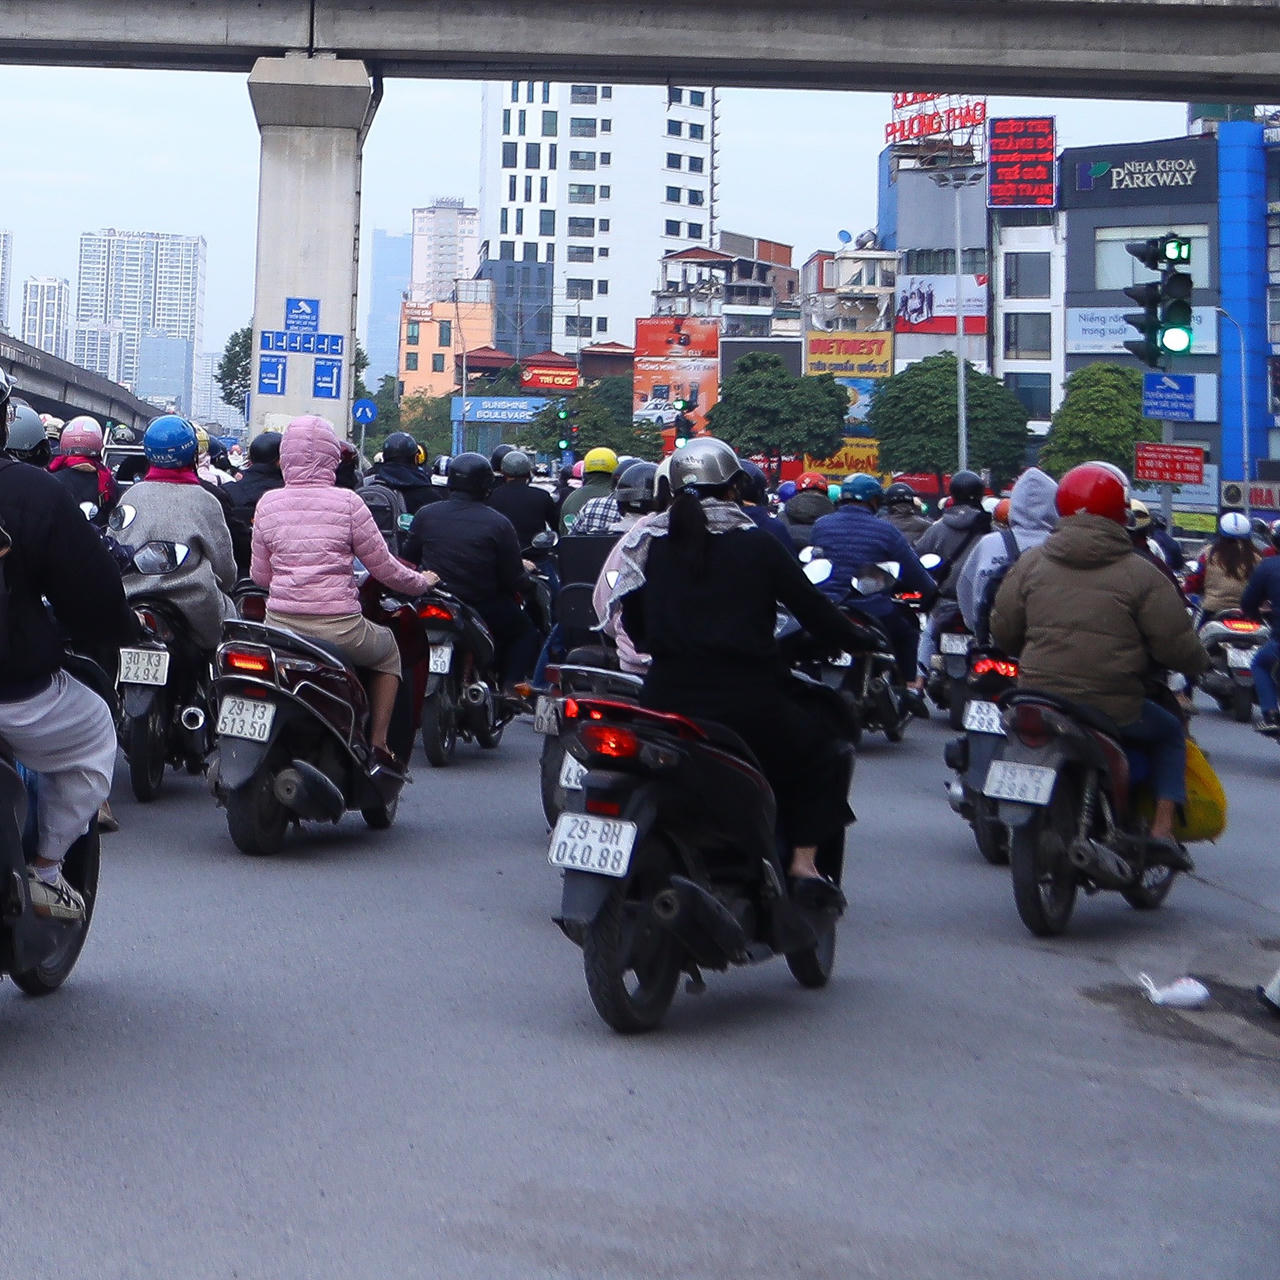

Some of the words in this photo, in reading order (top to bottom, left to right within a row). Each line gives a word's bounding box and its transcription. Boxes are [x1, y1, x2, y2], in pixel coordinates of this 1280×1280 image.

[1124, 161, 1154, 172] NHA
[1155, 159, 1196, 171] KHOA
[1110, 168, 1197, 190] PARKWAY
[481, 401, 528, 410] SUNSHINE
[219, 717, 267, 739] 513.50
[555, 839, 624, 870] 040.88
